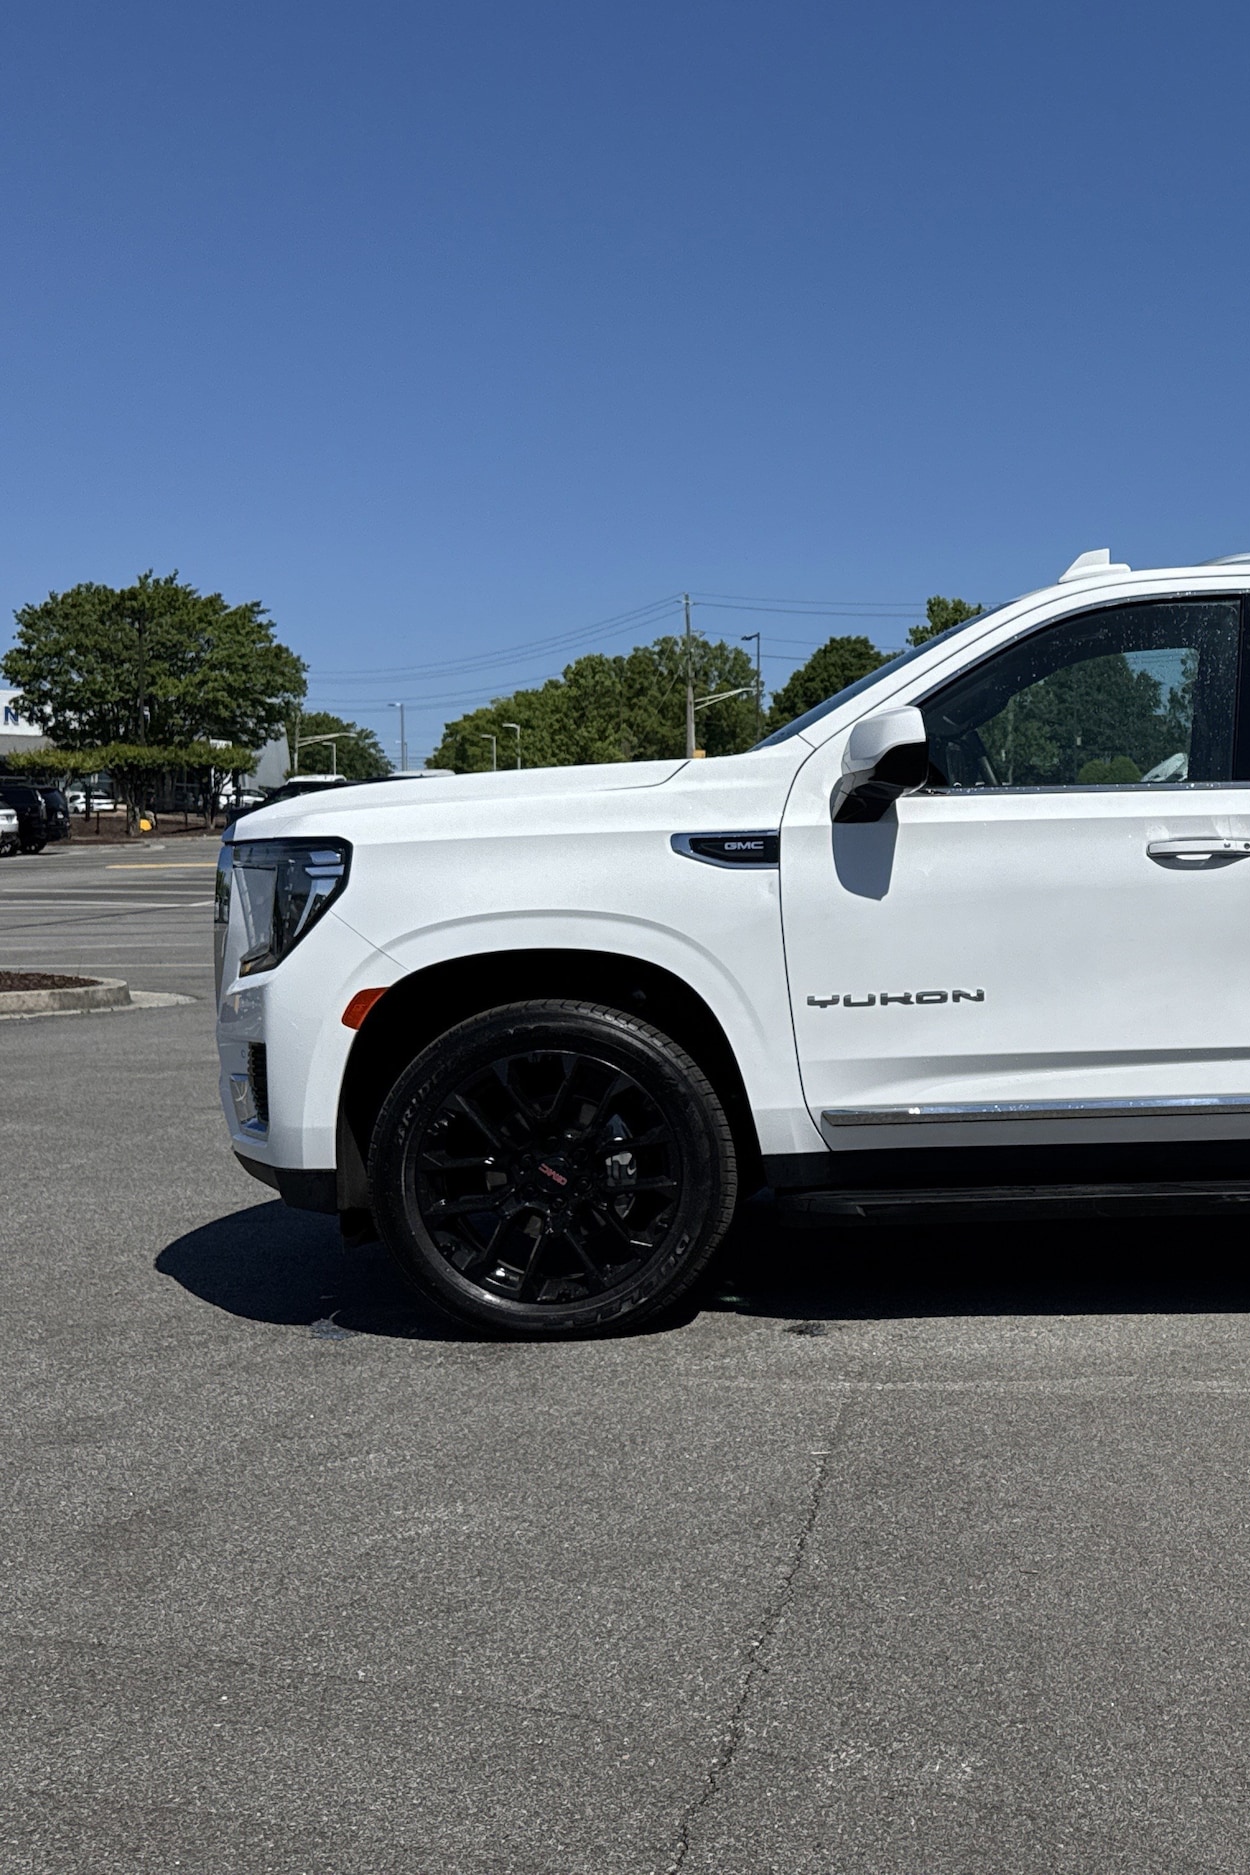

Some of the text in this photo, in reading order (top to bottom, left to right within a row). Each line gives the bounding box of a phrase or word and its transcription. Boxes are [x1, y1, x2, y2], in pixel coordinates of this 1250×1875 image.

[724, 841, 764, 850] GMC
[807, 989, 985, 1008] YUKON
[538, 1163, 568, 1186] GMC
